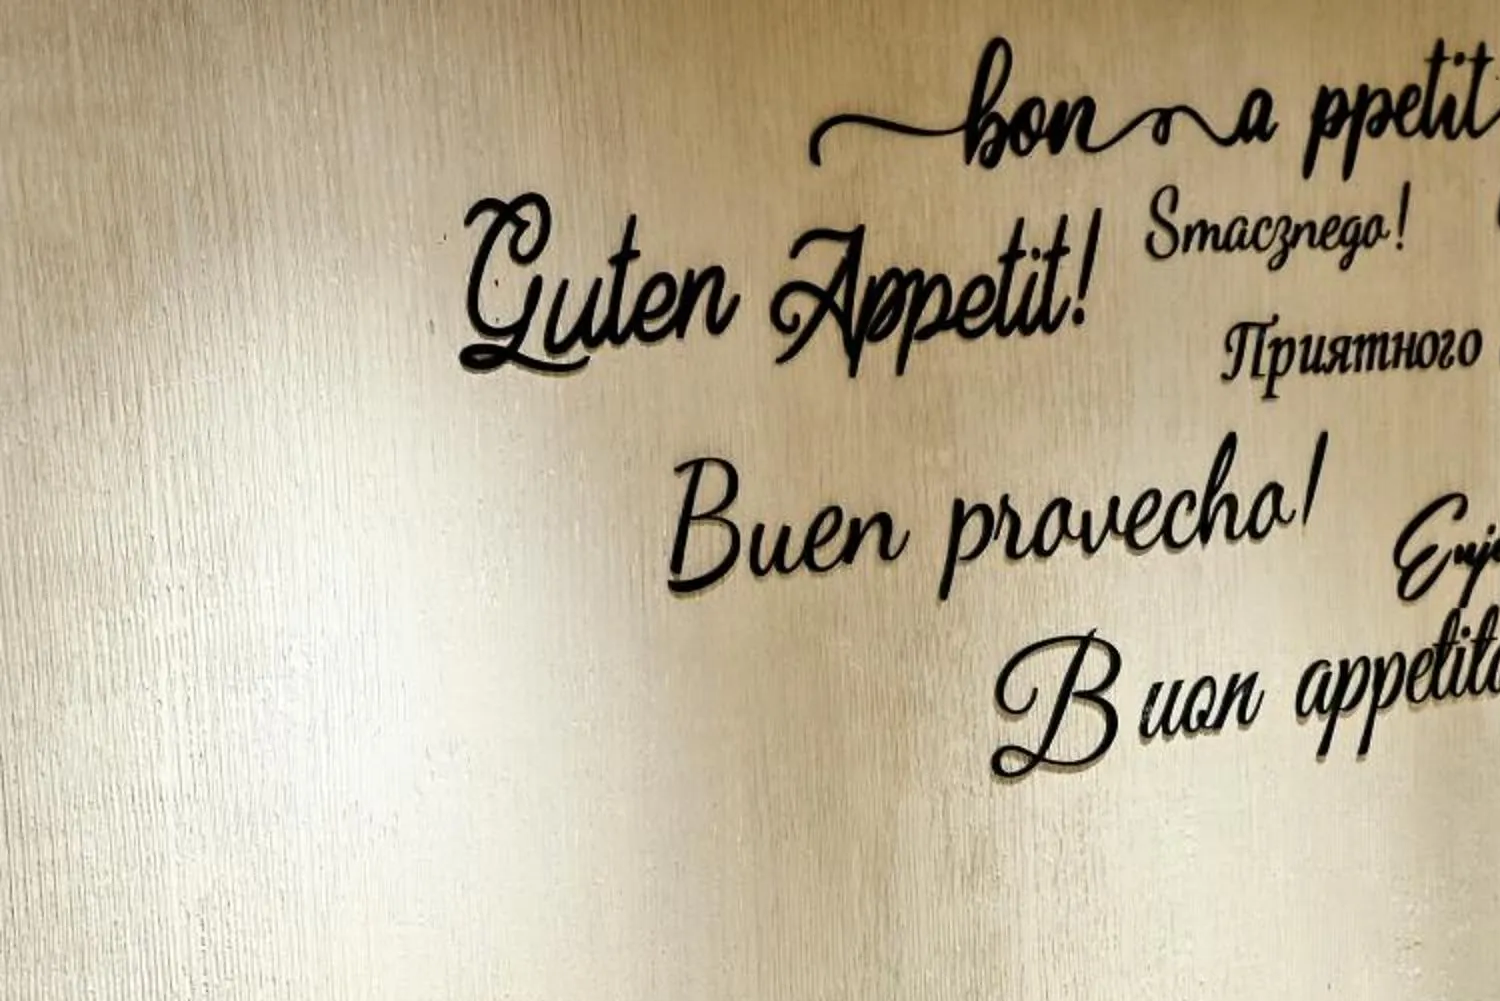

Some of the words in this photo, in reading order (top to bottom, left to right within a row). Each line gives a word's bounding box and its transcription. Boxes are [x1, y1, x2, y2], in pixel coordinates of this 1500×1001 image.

[459, 191, 741, 375] Guten
[769, 207, 1102, 379] Appetit!
[1145, 181, 1411, 272] Smacznego!
[1220, 313, 1483, 400] Приятного
[667, 457, 911, 594] Buen
[990, 628, 1266, 780] Buon
